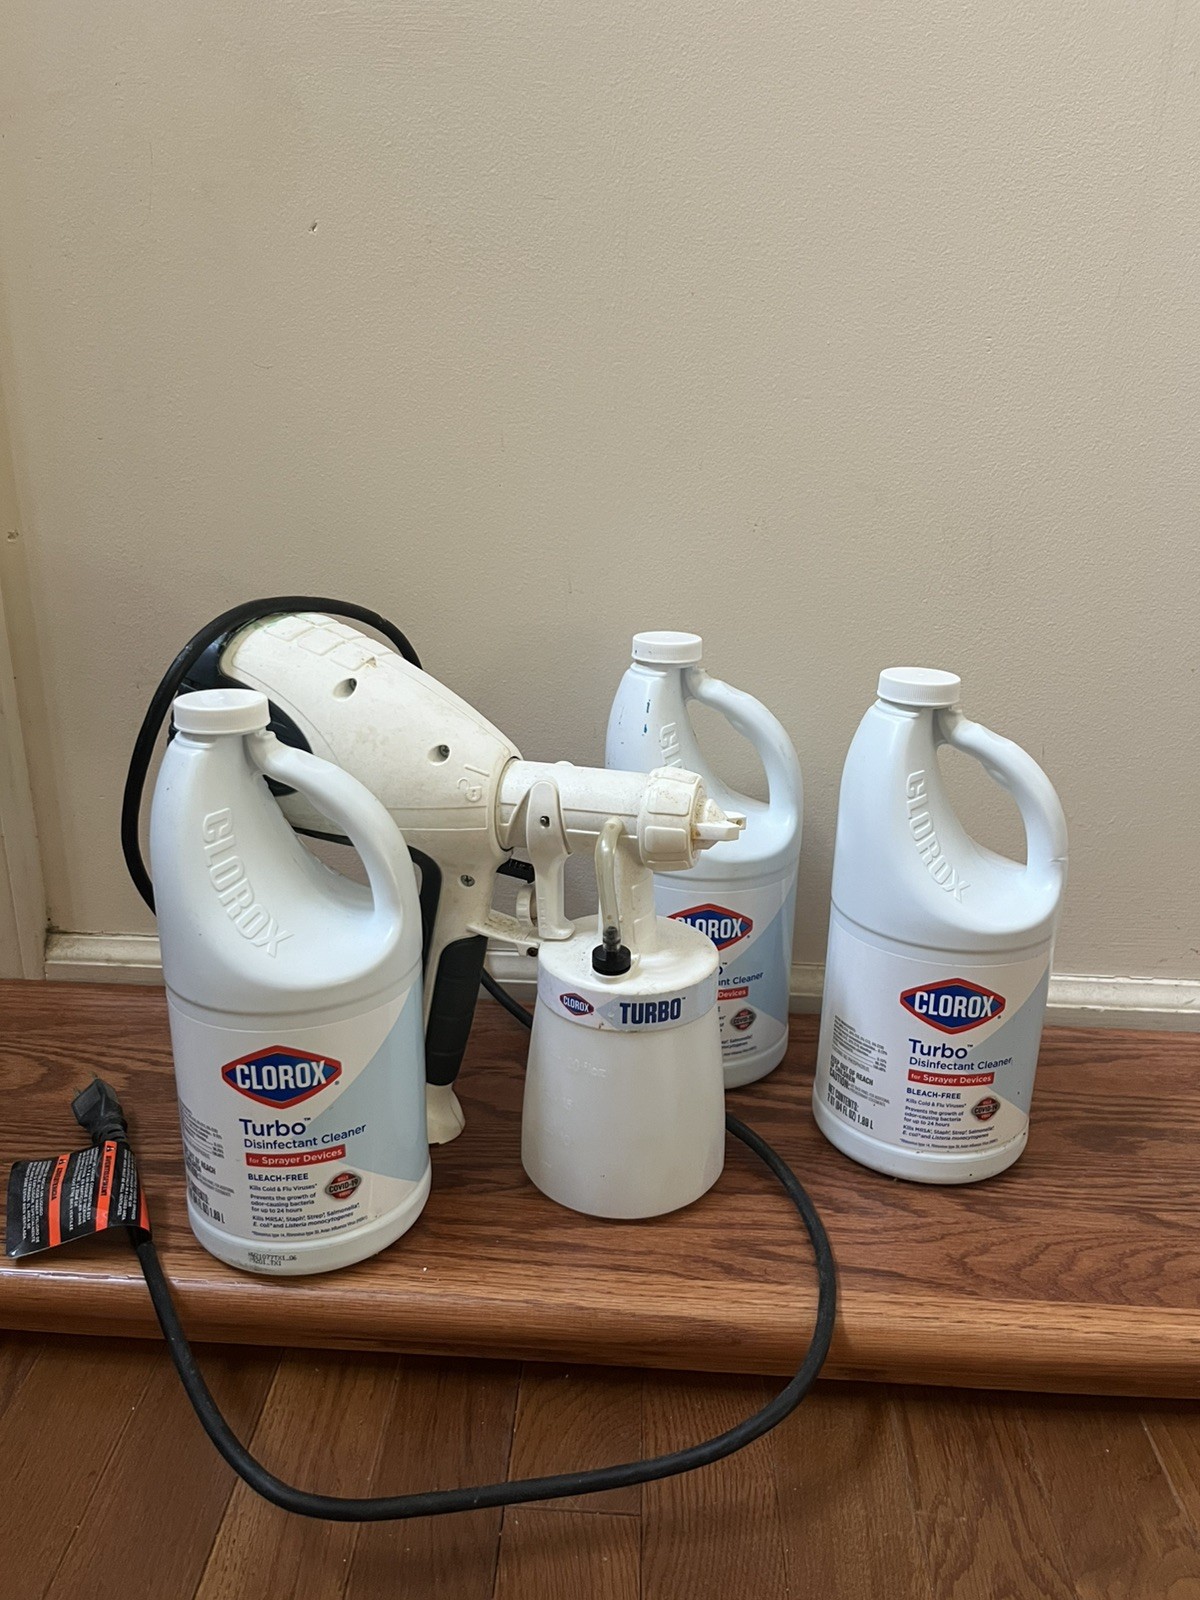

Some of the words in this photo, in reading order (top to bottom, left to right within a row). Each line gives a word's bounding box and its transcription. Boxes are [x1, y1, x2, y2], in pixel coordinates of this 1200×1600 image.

[906, 770, 971, 904] CLOROX
[203, 808, 295, 958] CLOROX
[676, 917, 742, 938] OROX
[733, 972, 764, 985] Cleaner
[564, 996, 589, 1012] CLOROX
[914, 991, 995, 1018] CLOROX
[910, 1056, 974, 1070] Disinfectant
[977, 1057, 1012, 1070] Cleaner
[236, 1060, 326, 1090] CLOROX
[923, 1074, 957, 1084] Sprayer
[960, 1075, 992, 1083] Devices
[906, 1088, 961, 1099] BLEACH-FREE
[904, 1112, 939, 1122] odor-causing
[905, 1106, 928, 1114] Prevents
[244, 1137, 318, 1149] Disinfectant
[322, 1124, 367, 1144] Cleaner
[262, 1156, 300, 1166] Sprayer
[303, 1149, 342, 1162] Devices
[248, 1173, 309, 1182] BLEACH-FREE
